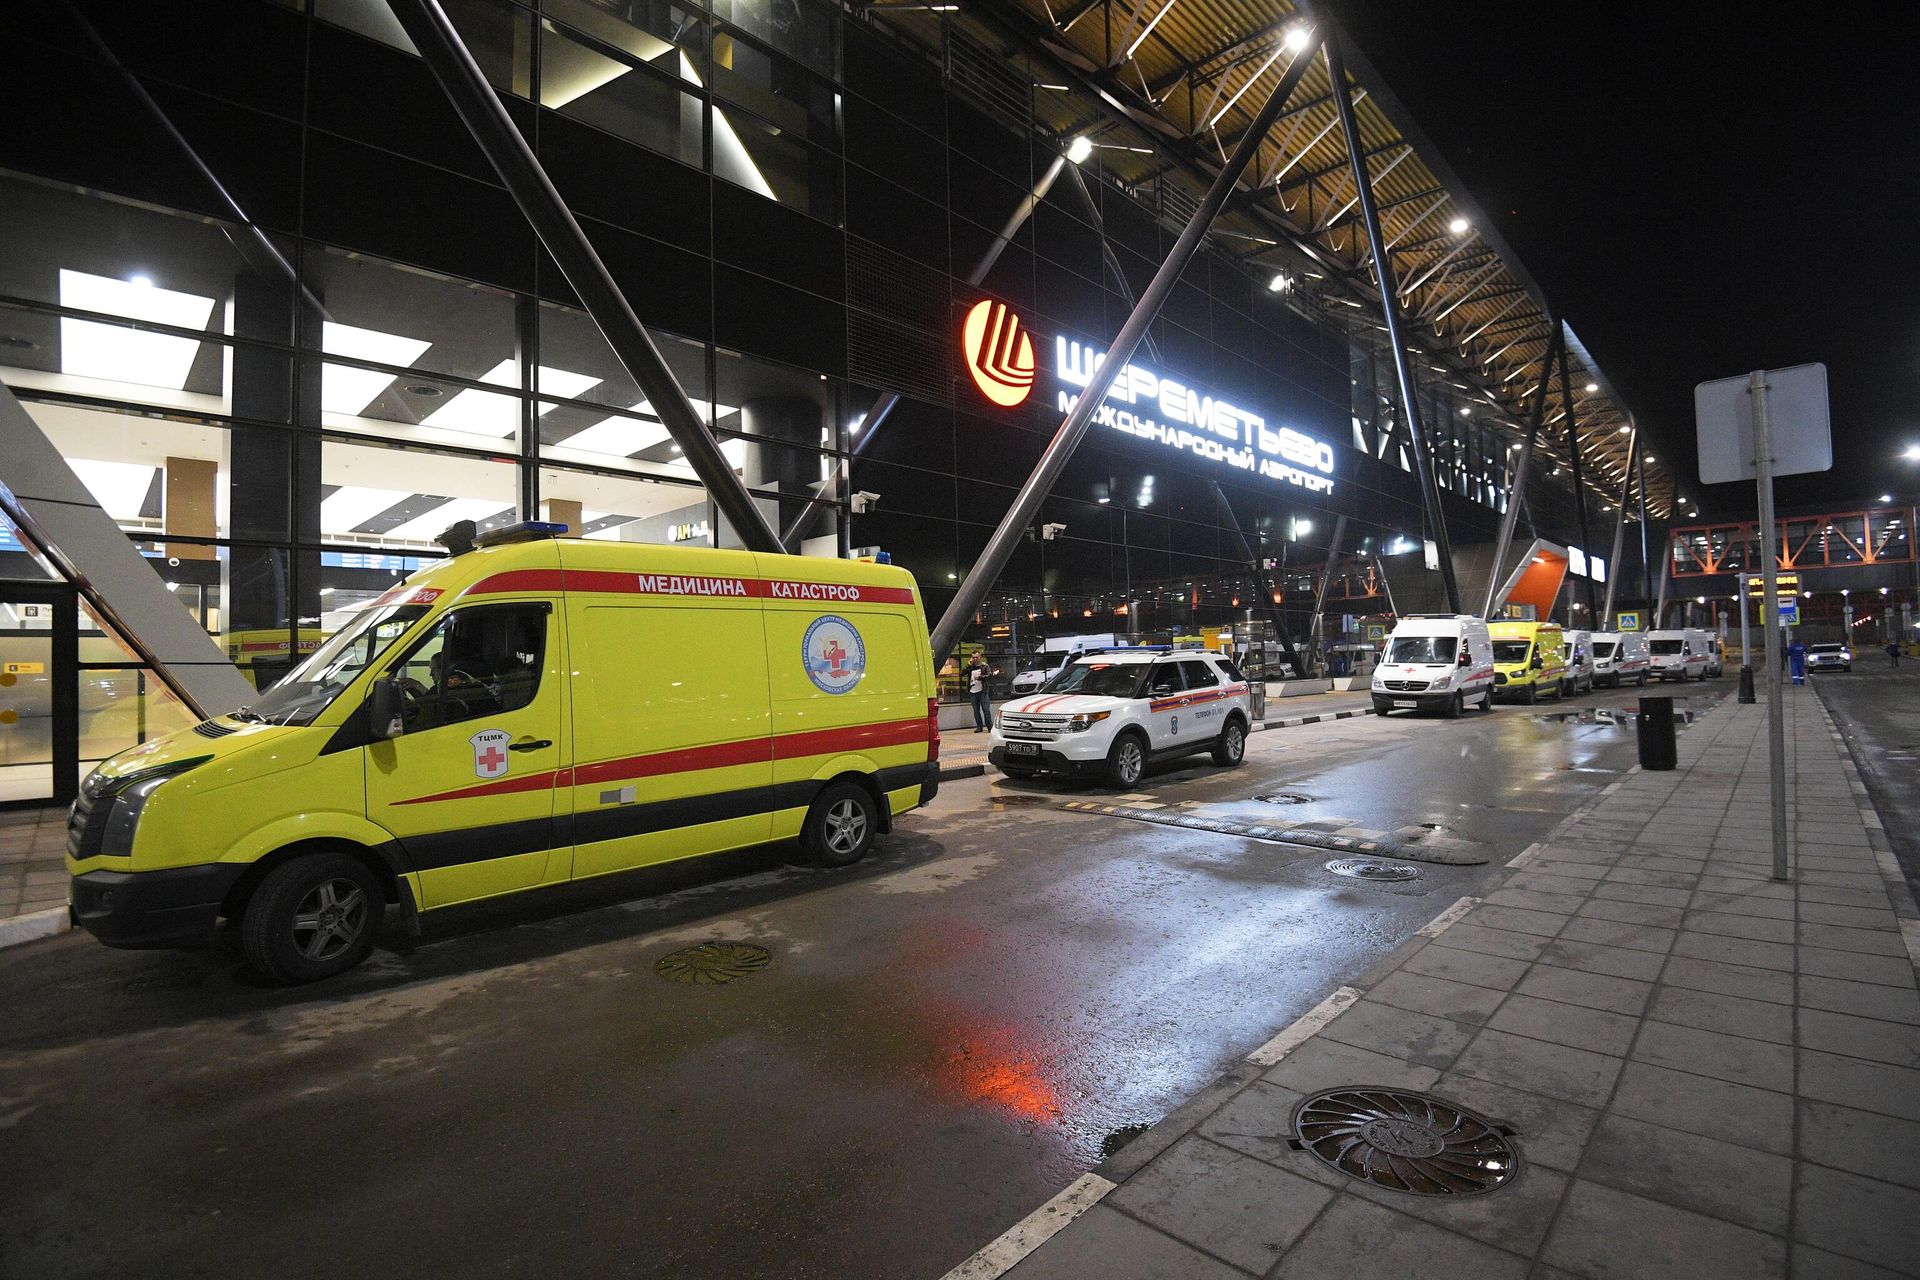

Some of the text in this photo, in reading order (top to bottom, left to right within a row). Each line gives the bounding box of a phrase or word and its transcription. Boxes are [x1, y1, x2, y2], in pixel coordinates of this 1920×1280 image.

[1058, 390, 1334, 495] МЖДУНАРОДНЫЙ АЭРОПОРТ
[638, 575, 860, 601] МЕДИЦИНА КАТАСТРОФ
[478, 733, 503, 742] ТЦМК
